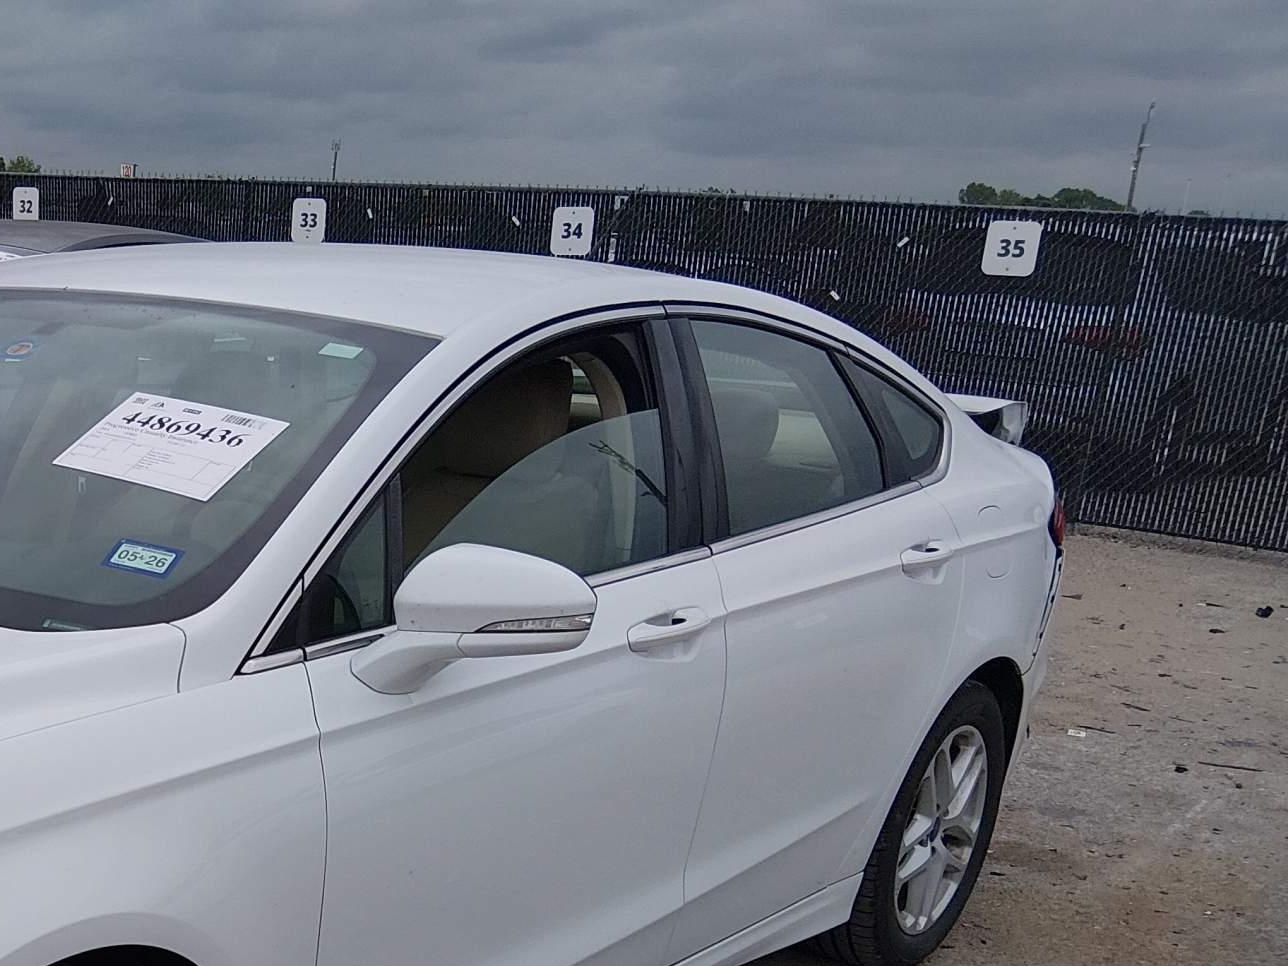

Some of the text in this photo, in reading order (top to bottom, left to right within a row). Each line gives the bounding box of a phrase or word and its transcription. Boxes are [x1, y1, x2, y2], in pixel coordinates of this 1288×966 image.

[19, 200, 33, 213] 32
[300, 213, 318, 228] 33
[561, 222, 583, 239] 34
[997, 239, 1026, 258] 35
[122, 411, 250, 448] 44869436
[117, 549, 140, 562] 05
[143, 555, 169, 568] 26
